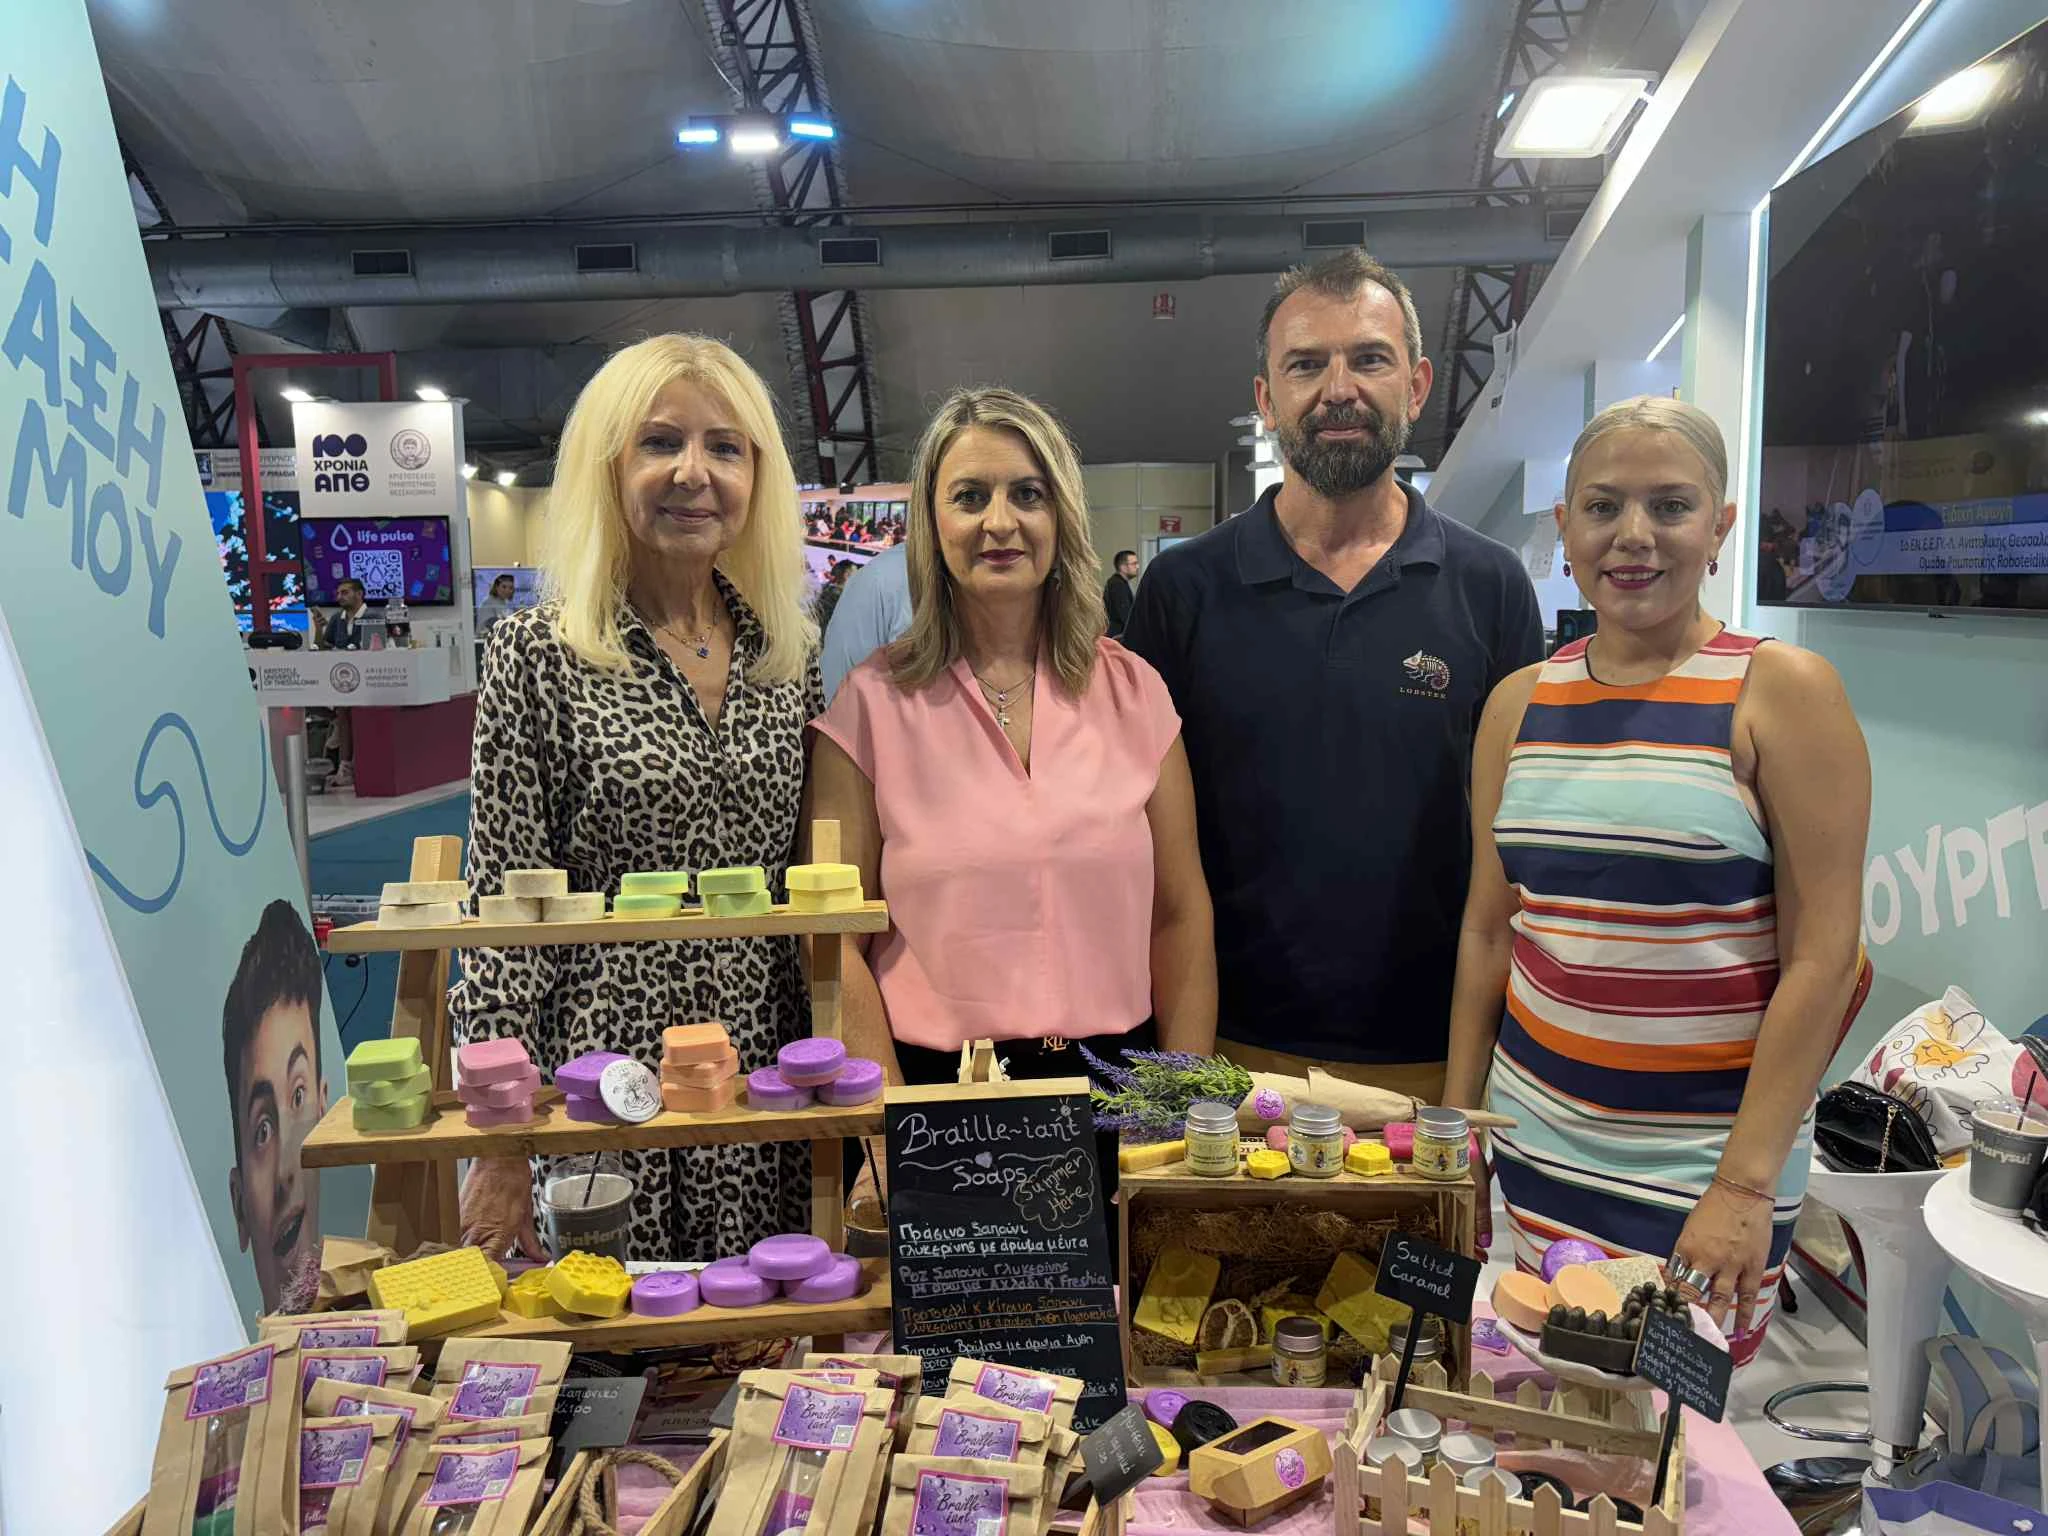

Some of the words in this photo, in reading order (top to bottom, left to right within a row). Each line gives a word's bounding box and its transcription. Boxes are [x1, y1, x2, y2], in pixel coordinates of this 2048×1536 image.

[313, 434, 367, 457] 100
[314, 460, 368, 472] ΧΡΟΝΙΑ
[315, 473, 369, 492] ΑΠΘ
[8, 398, 182, 640] ΜΟΥ
[357, 530, 379, 543] life
[381, 531, 415, 544] pulse
[952, 1164, 1028, 1197] Soaps
[1020, 1154, 1084, 1202] Summer
[1051, 1183, 1066, 1197] is
[1049, 1184, 1089, 1222] Here
[899, 1221, 966, 1245] Πράσινο
[980, 1240, 996, 1257] με
[1047, 1234, 1088, 1254] μέντα
[1396, 1241, 1454, 1278] Salted
[1390, 1263, 1450, 1299] Caramel
